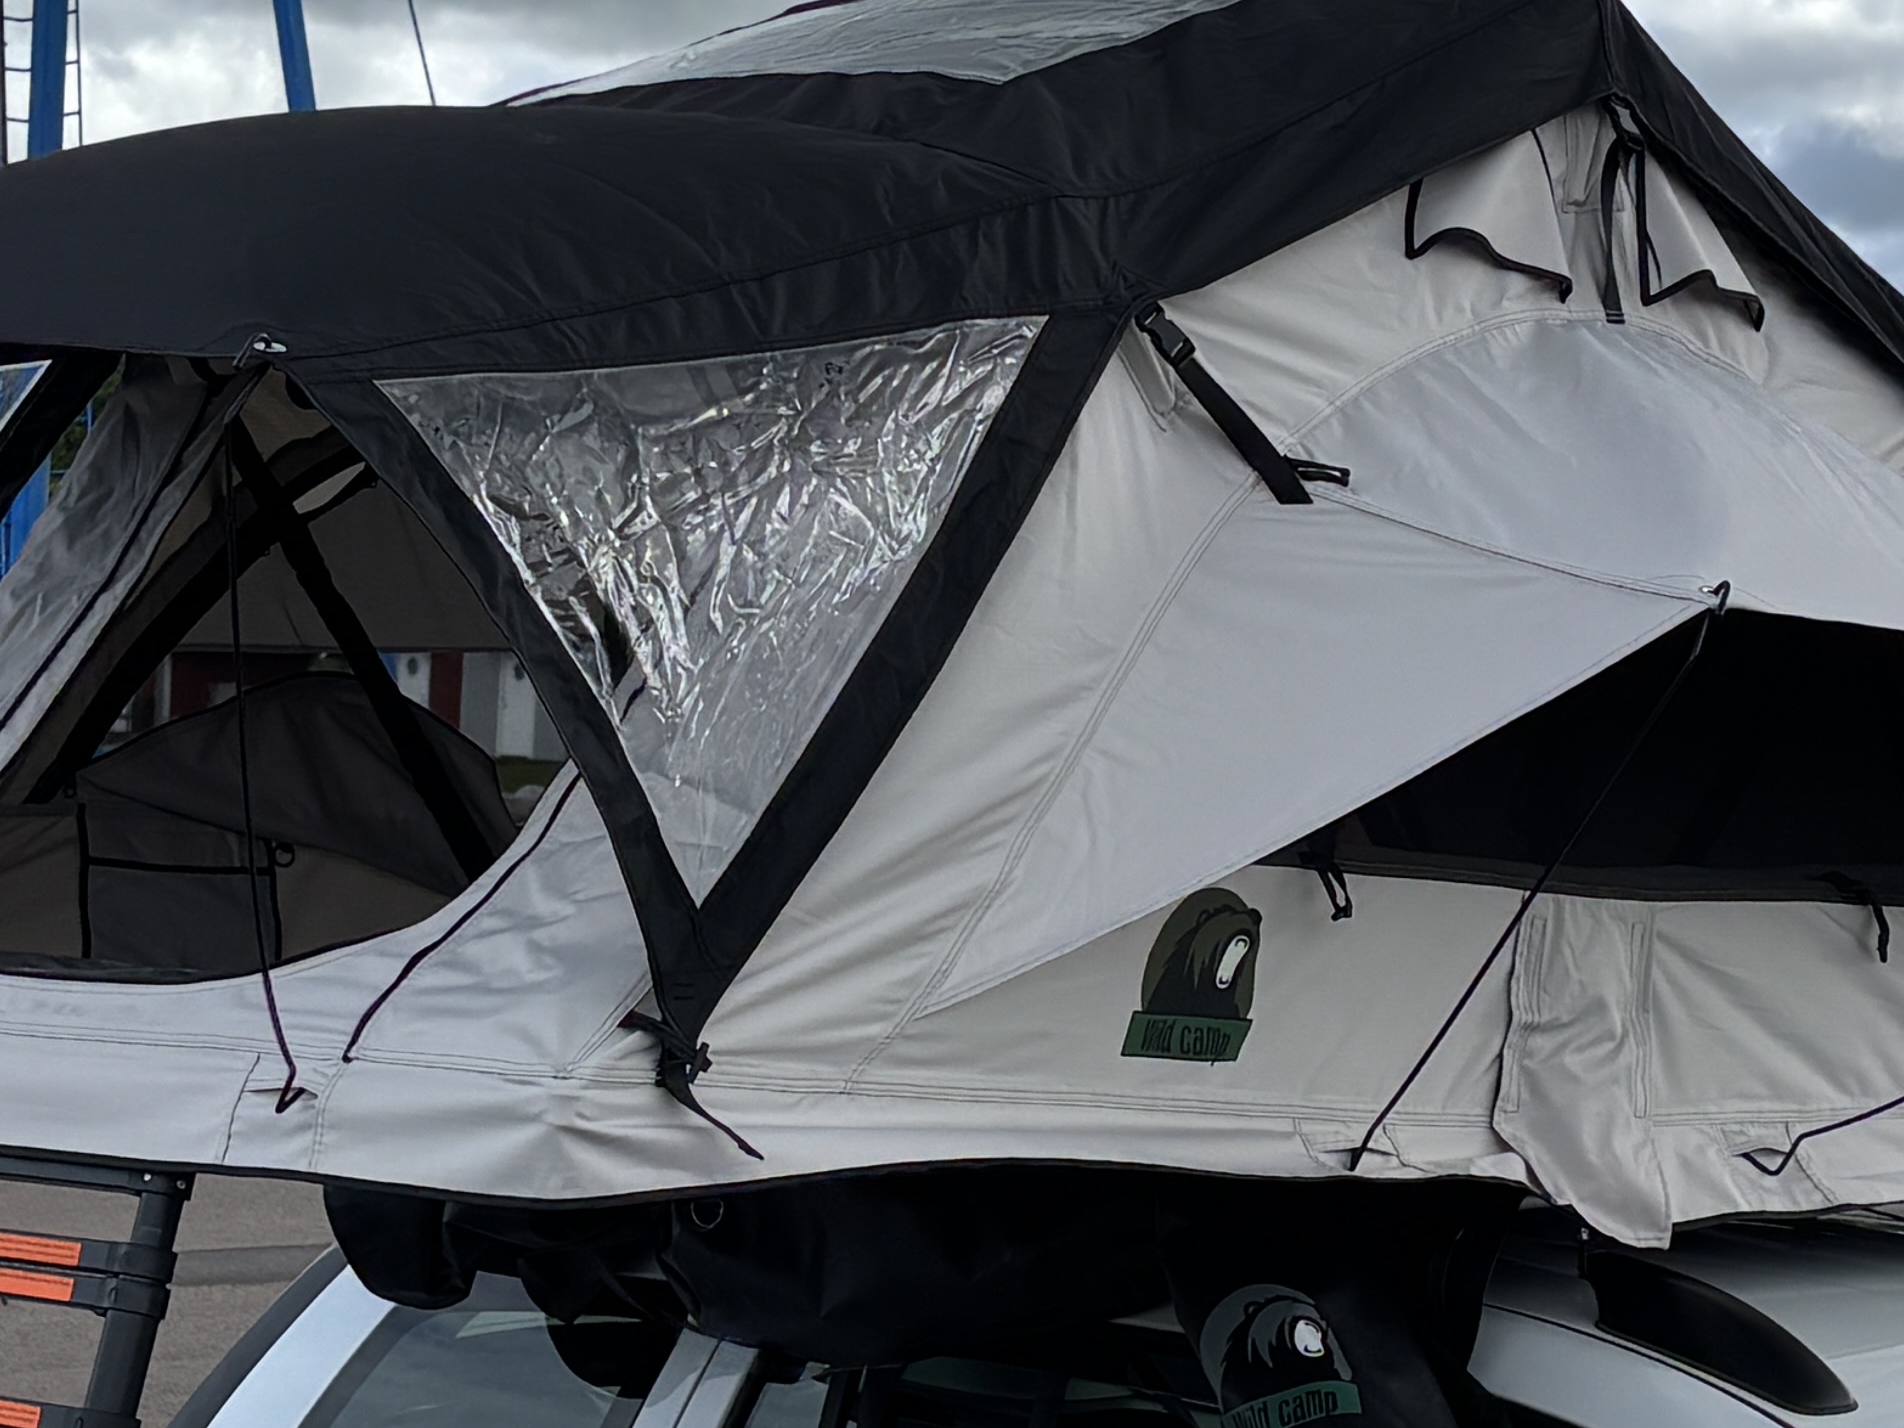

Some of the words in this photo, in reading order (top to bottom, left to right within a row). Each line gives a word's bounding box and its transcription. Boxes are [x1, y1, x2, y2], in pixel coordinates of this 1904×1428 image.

[1141, 1018, 1177, 1053] Wild
[1180, 1025, 1231, 1066] camp
[1278, 1389, 1338, 1428] camp
